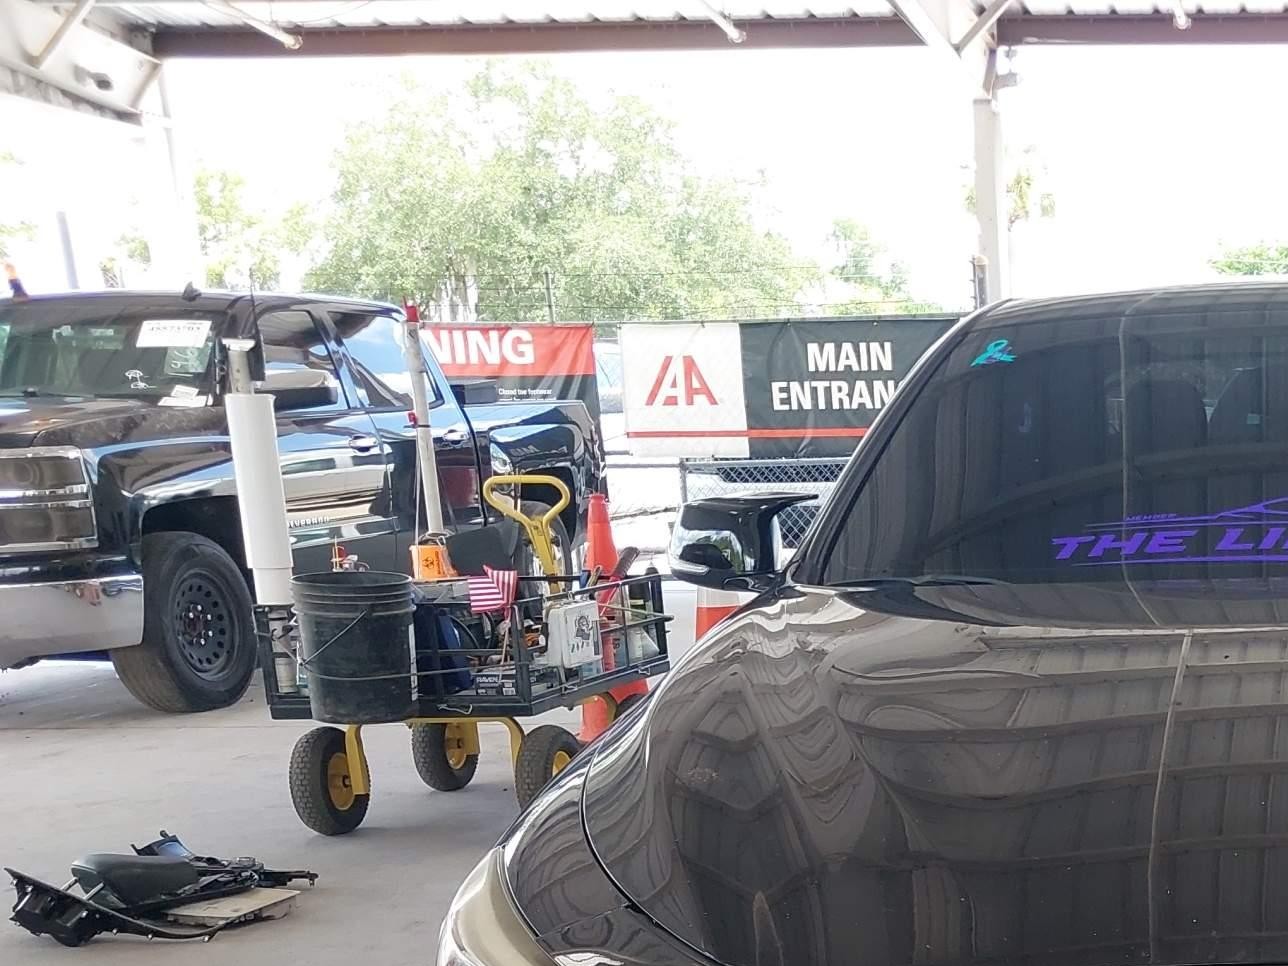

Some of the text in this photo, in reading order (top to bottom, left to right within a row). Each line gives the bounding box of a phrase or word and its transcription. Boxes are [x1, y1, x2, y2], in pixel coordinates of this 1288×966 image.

[806, 341, 893, 372] MAIN
[771, 379, 903, 411] ENTRAN
[1051, 529, 1198, 560] THE
